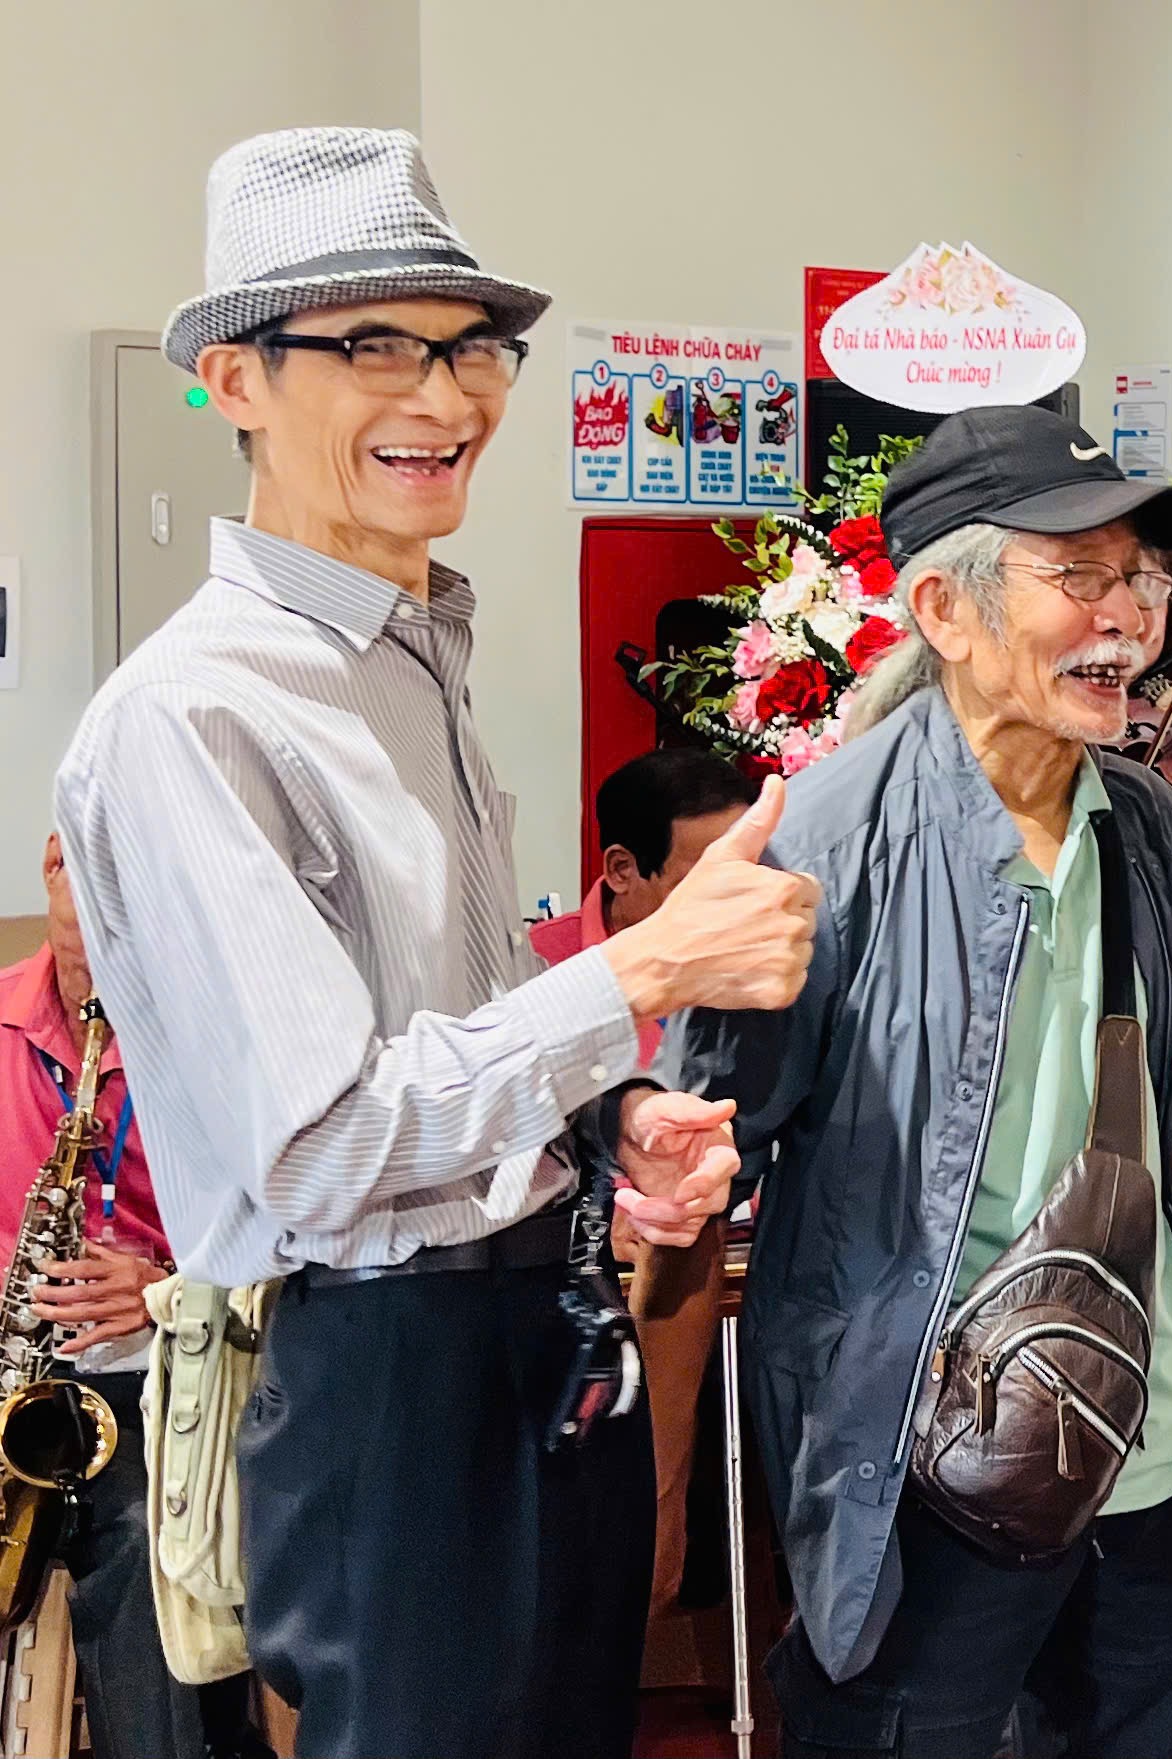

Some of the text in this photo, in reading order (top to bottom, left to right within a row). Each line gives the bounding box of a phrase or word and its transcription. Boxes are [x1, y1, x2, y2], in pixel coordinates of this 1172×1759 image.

[611, 331, 762, 362] TIÊU LỆNH CHỮA CHÁY
[832, 327, 859, 354] Đại
[864, 327, 879, 350] tá
[883, 327, 915, 350] Nhà
[920, 327, 948, 350] báo
[963, 327, 1007, 350] NSNA
[1011, 326, 1051, 350] Xuân
[598, 367, 605, 379] 1
[656, 370, 663, 382] 2
[906, 361, 942, 384] Chúc
[712, 373, 720, 386] 3
[767, 377, 774, 388] 4
